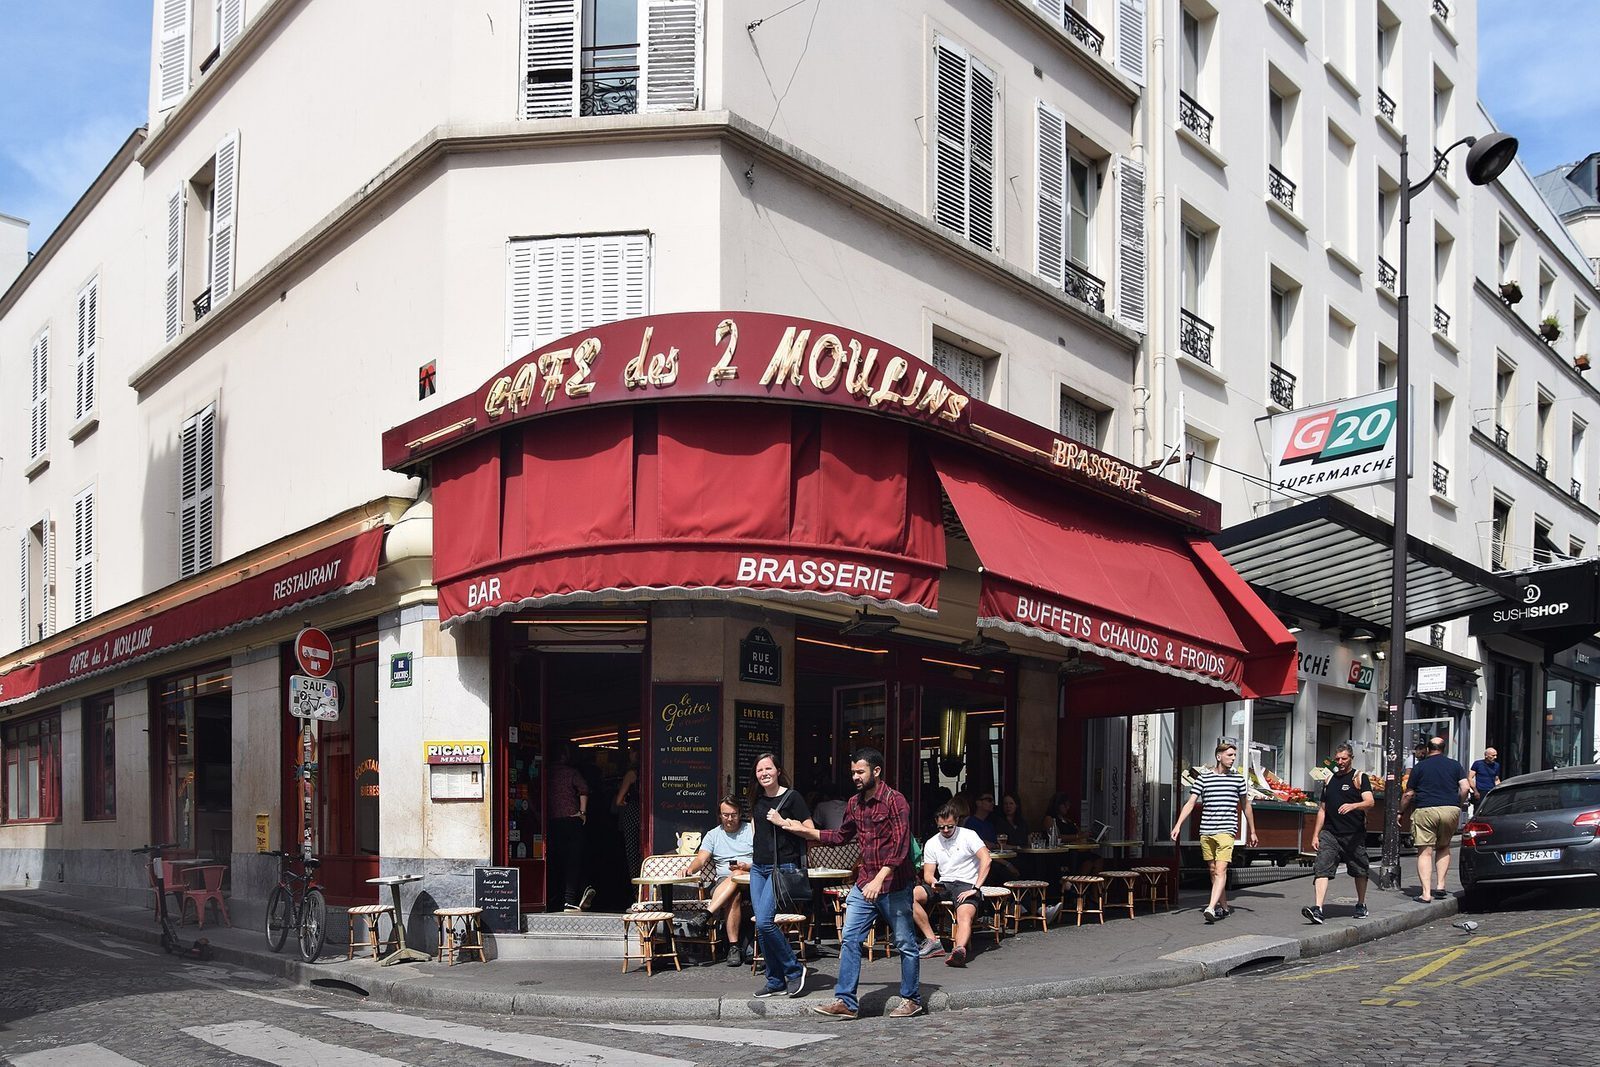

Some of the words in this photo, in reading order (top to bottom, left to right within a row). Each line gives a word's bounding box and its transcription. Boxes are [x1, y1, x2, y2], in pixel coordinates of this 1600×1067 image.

[624, 326, 680, 389] des
[706, 319, 739, 384] 2
[758, 326, 969, 423] MOULINS
[1293, 408, 1391, 450] G20
[1052, 438, 1143, 493] BRASSERIE
[1277, 456, 1395, 491] SUPERMARCHÉ
[273, 559, 341, 600] RESTAURANT
[737, 556, 895, 594] BRASSERIE
[468, 577, 501, 607] BAR
[91, 647, 101, 666] des
[103, 641, 109, 662] 2
[112, 626, 153, 659] MOULINS
[1016, 596, 1092, 637] BUFFETS
[1099, 622, 1159, 656] CHAUDS
[1165, 644, 1174, 662] &
[1180, 646, 1225, 674] FROIDS
[748, 664, 773, 676] LEPIC
[752, 652, 770, 663] RUE
[303, 679, 327, 692] SAUF
[1350, 663, 1373, 685] G20
[679, 693, 691, 705] le
[743, 708, 775, 720] ENTREES
[676, 735, 700, 743] CAFÉ
[748, 732, 769, 742] PLATS
[428, 745, 484, 756] RICARD
